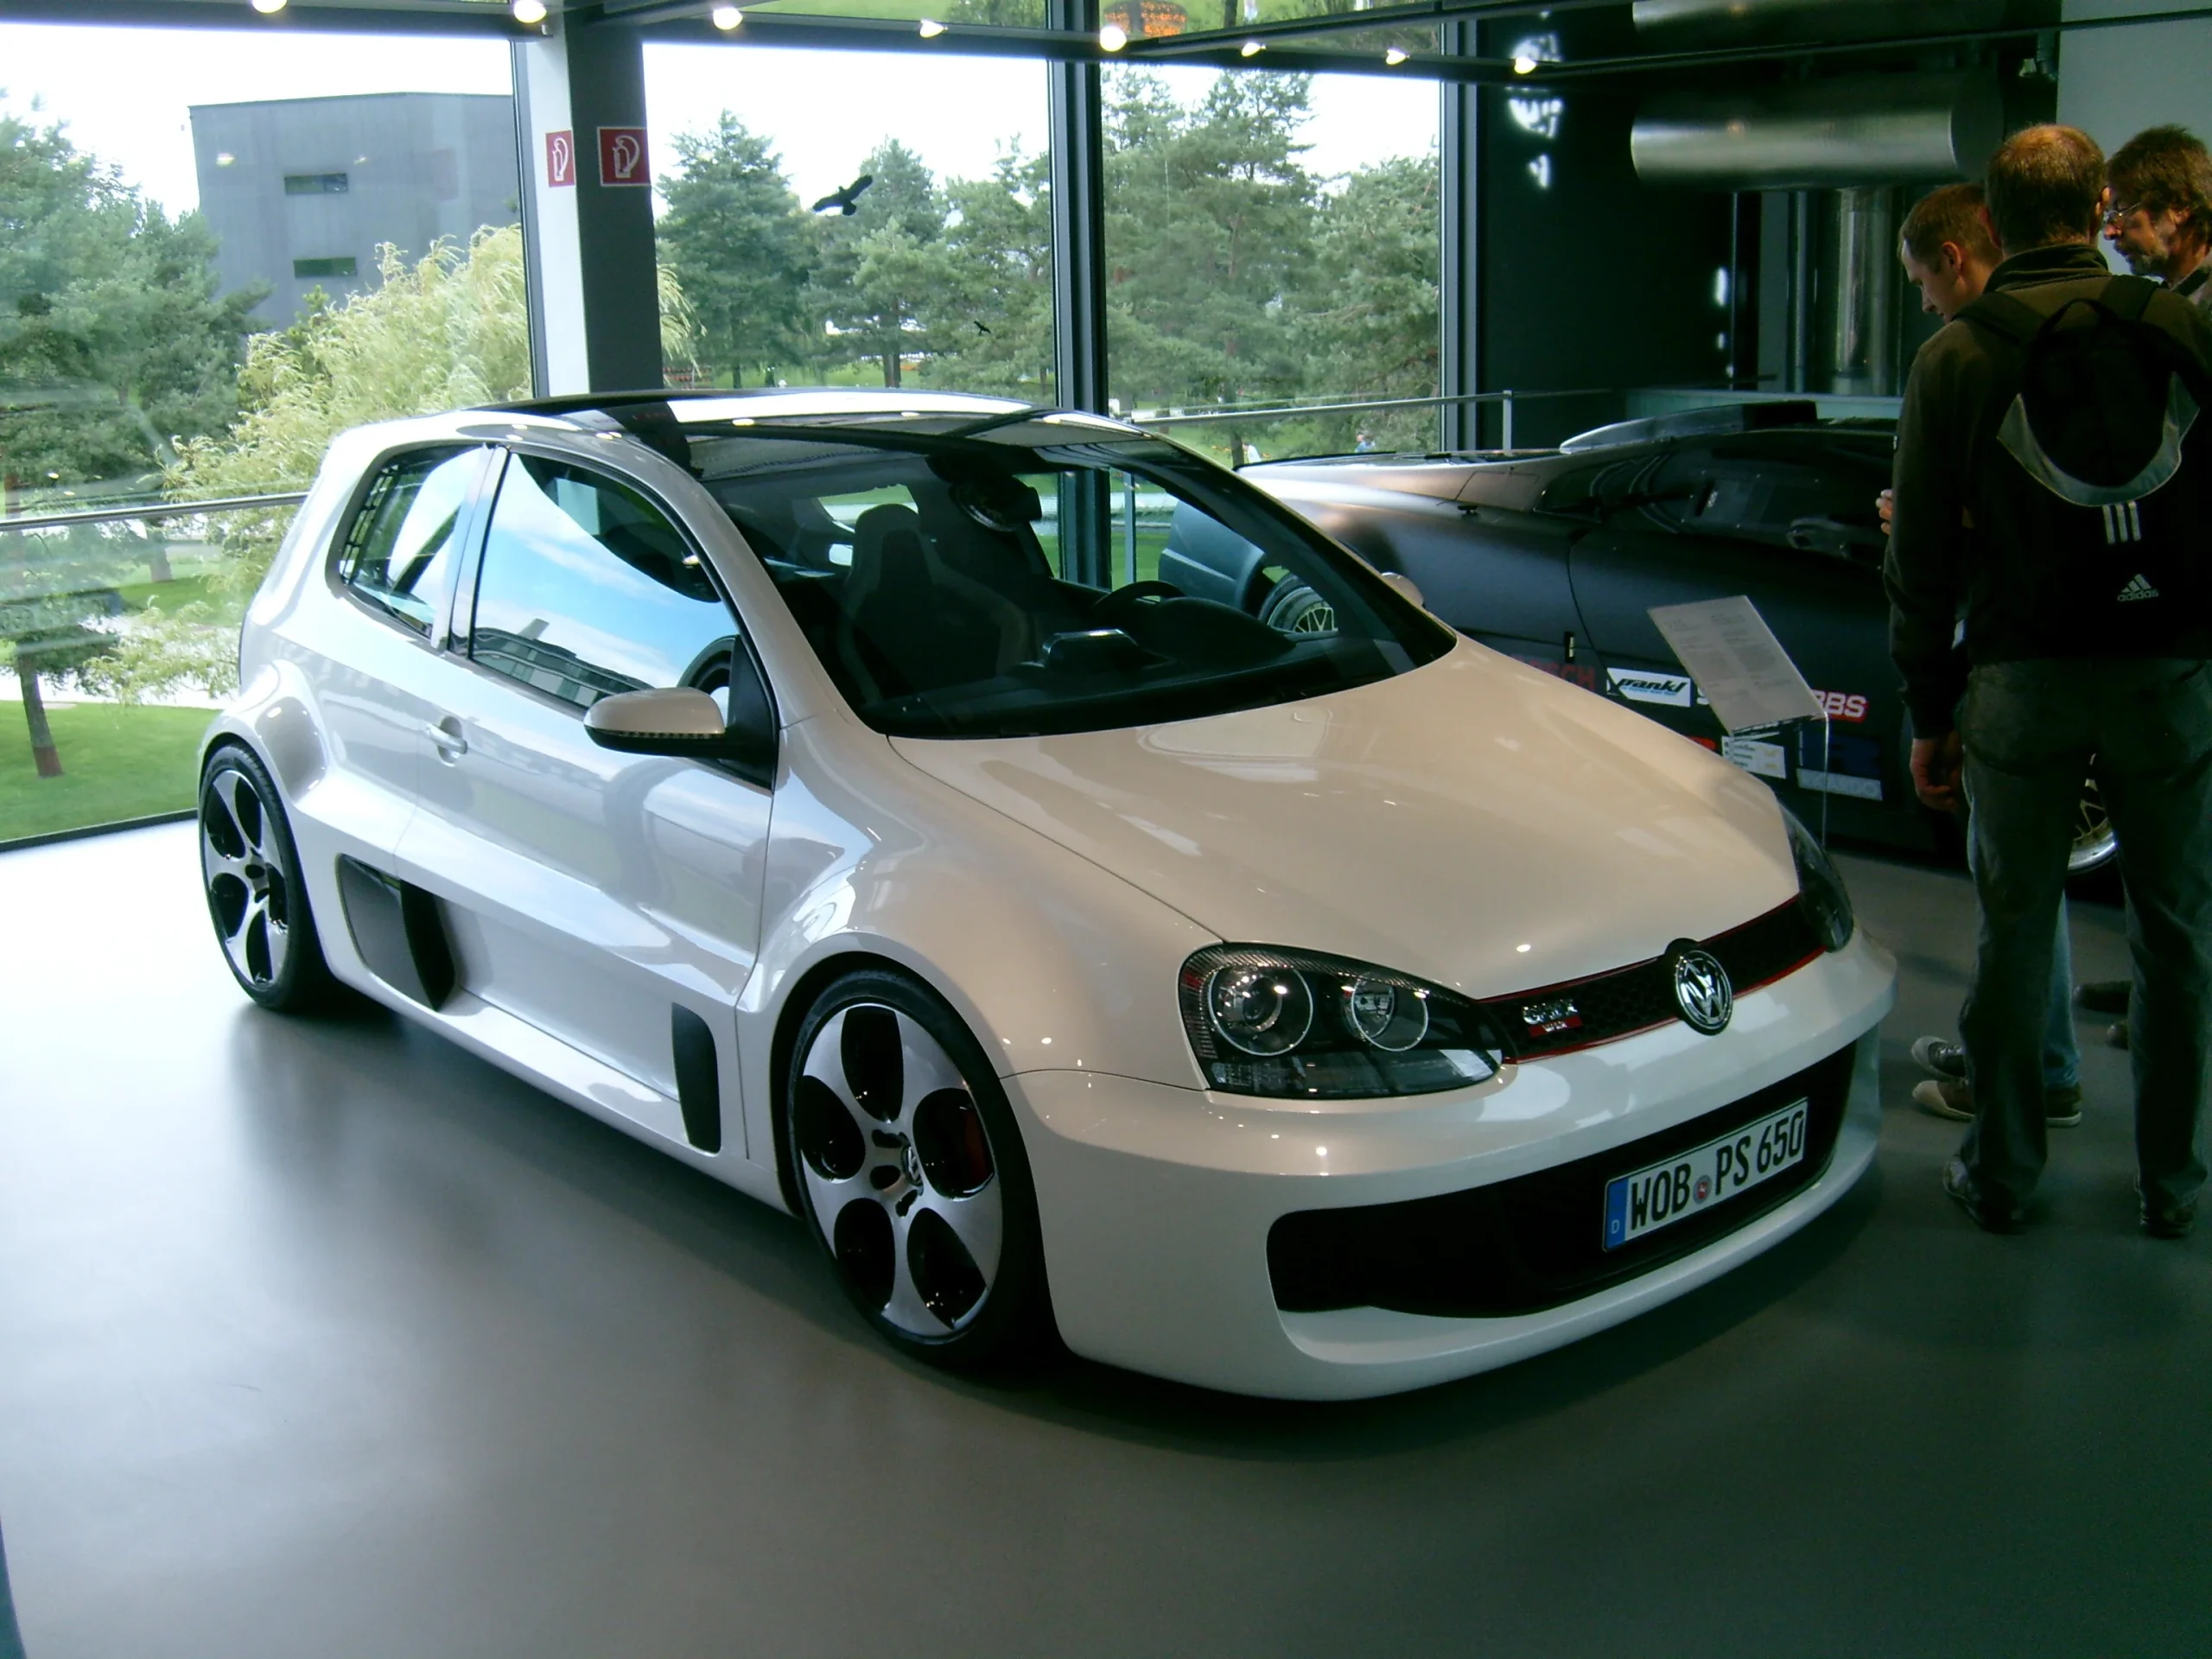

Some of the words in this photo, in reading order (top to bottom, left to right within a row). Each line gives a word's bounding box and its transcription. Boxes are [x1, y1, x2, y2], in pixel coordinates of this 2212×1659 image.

[2117, 589, 2159, 601] adidas
[1630, 1163, 1692, 1230] WOB
[1715, 1135, 1751, 1196] PS
[1758, 1109, 1804, 1173] 650
[1611, 1219, 1620, 1234] D
